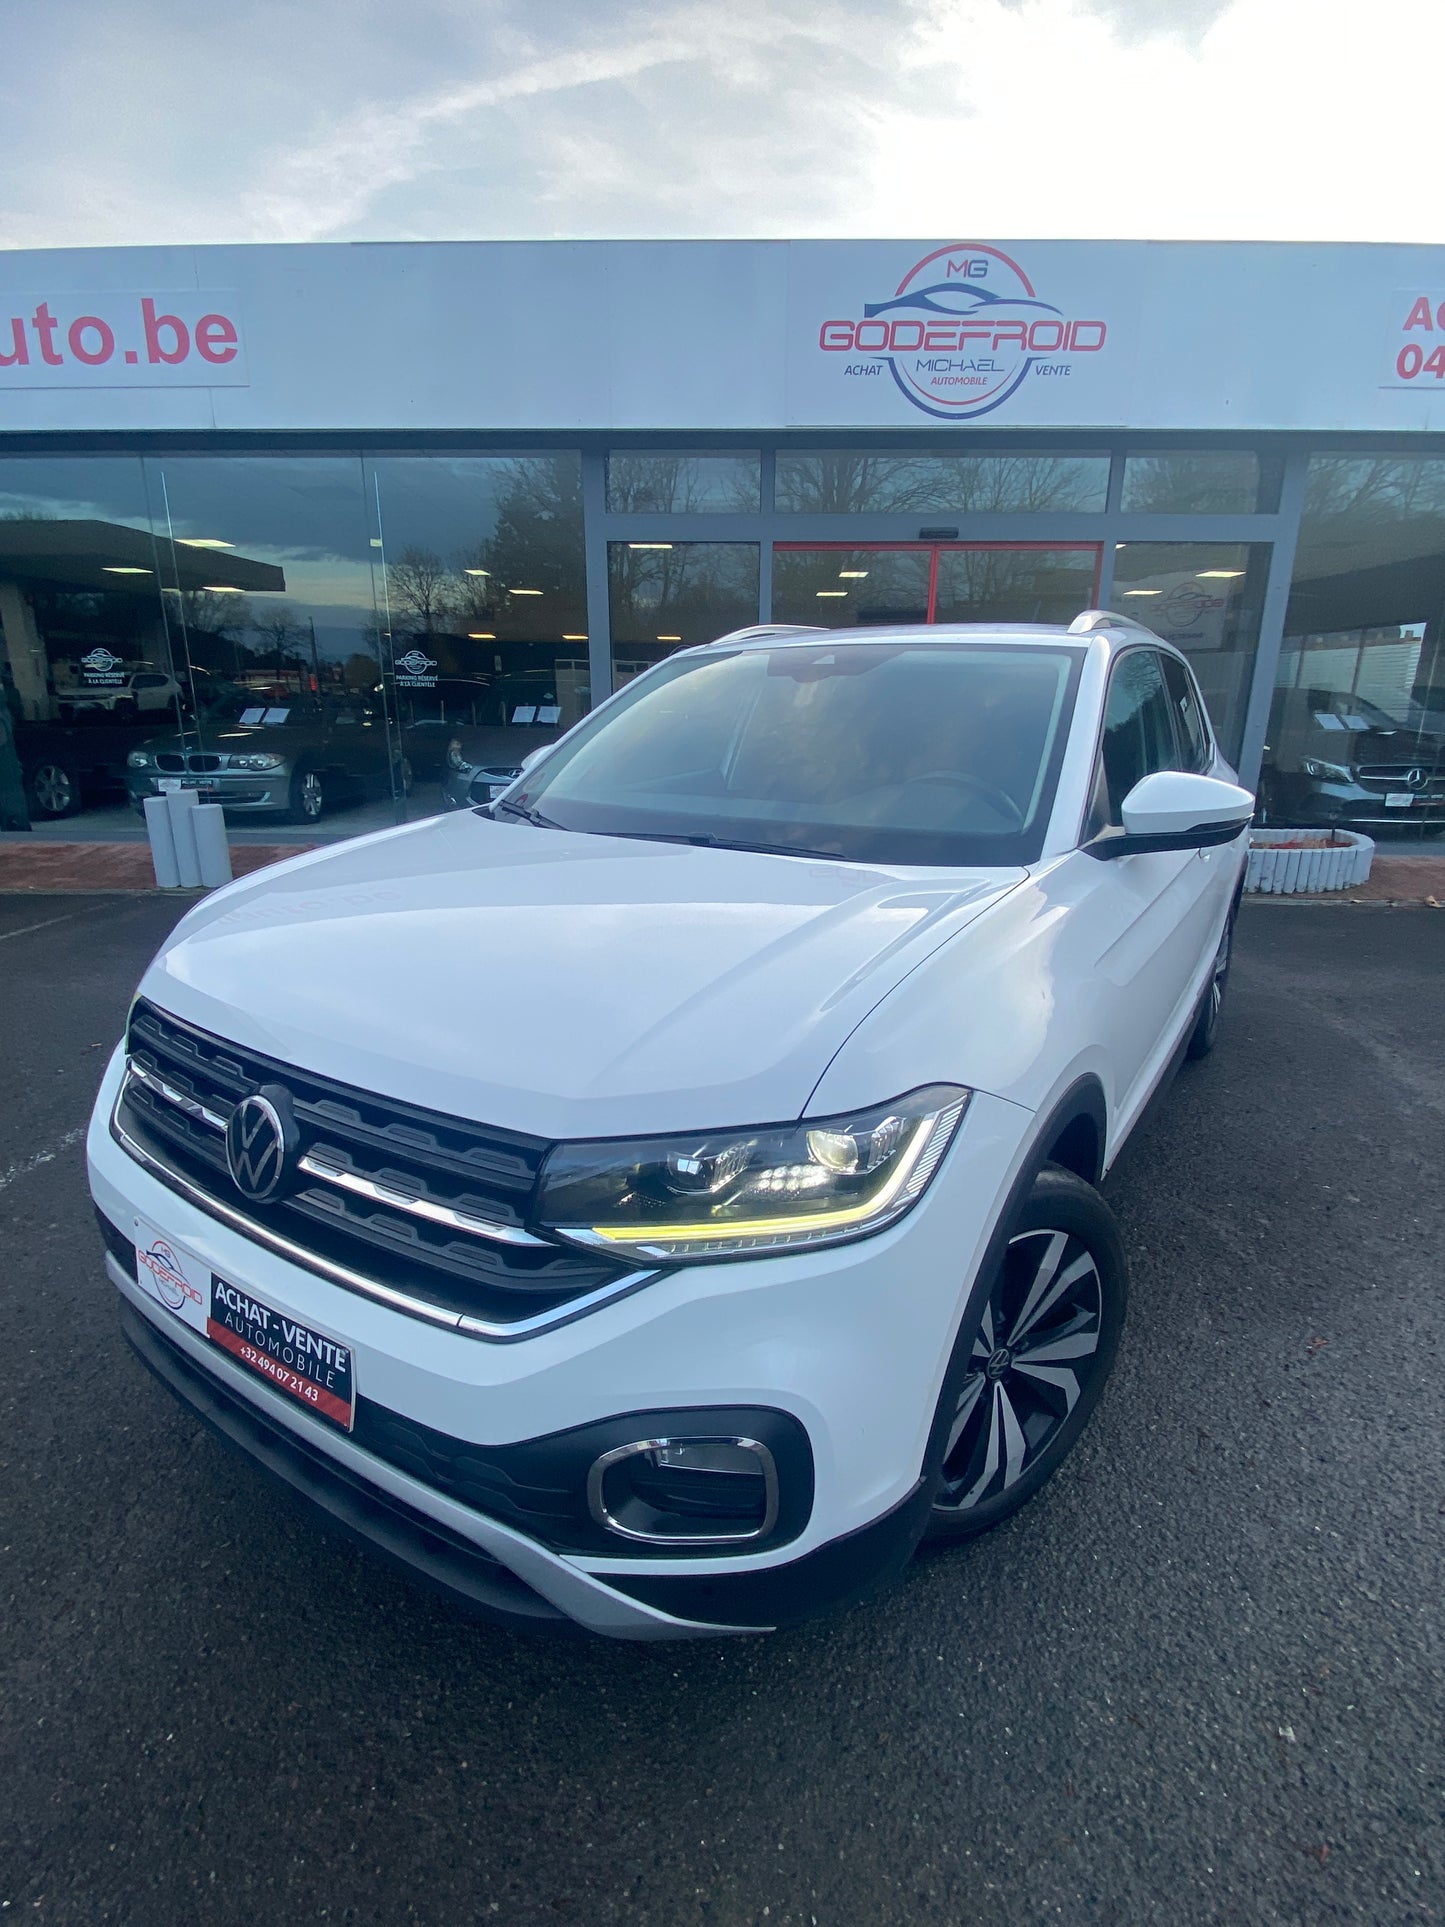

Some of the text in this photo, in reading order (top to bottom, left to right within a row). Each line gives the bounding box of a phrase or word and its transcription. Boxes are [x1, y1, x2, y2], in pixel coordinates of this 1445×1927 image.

[946, 259, 989, 278] MG
[819, 320, 1107, 351] GODEFROID
[844, 364, 883, 377] ACHAT
[915, 358, 1005, 373] MICHAEL
[1035, 364, 1071, 377] VENTE
[930, 376, 988, 386] AUTOMOBILE
[137, 1250, 203, 1306] GODEFROID
[215, 1282, 271, 1330] ACHAT
[281, 1319, 349, 1373] VENTE
[224, 1312, 336, 1390] AUTOMOBILE
[239, 1345, 319, 1402] +32 494 07 21 43
